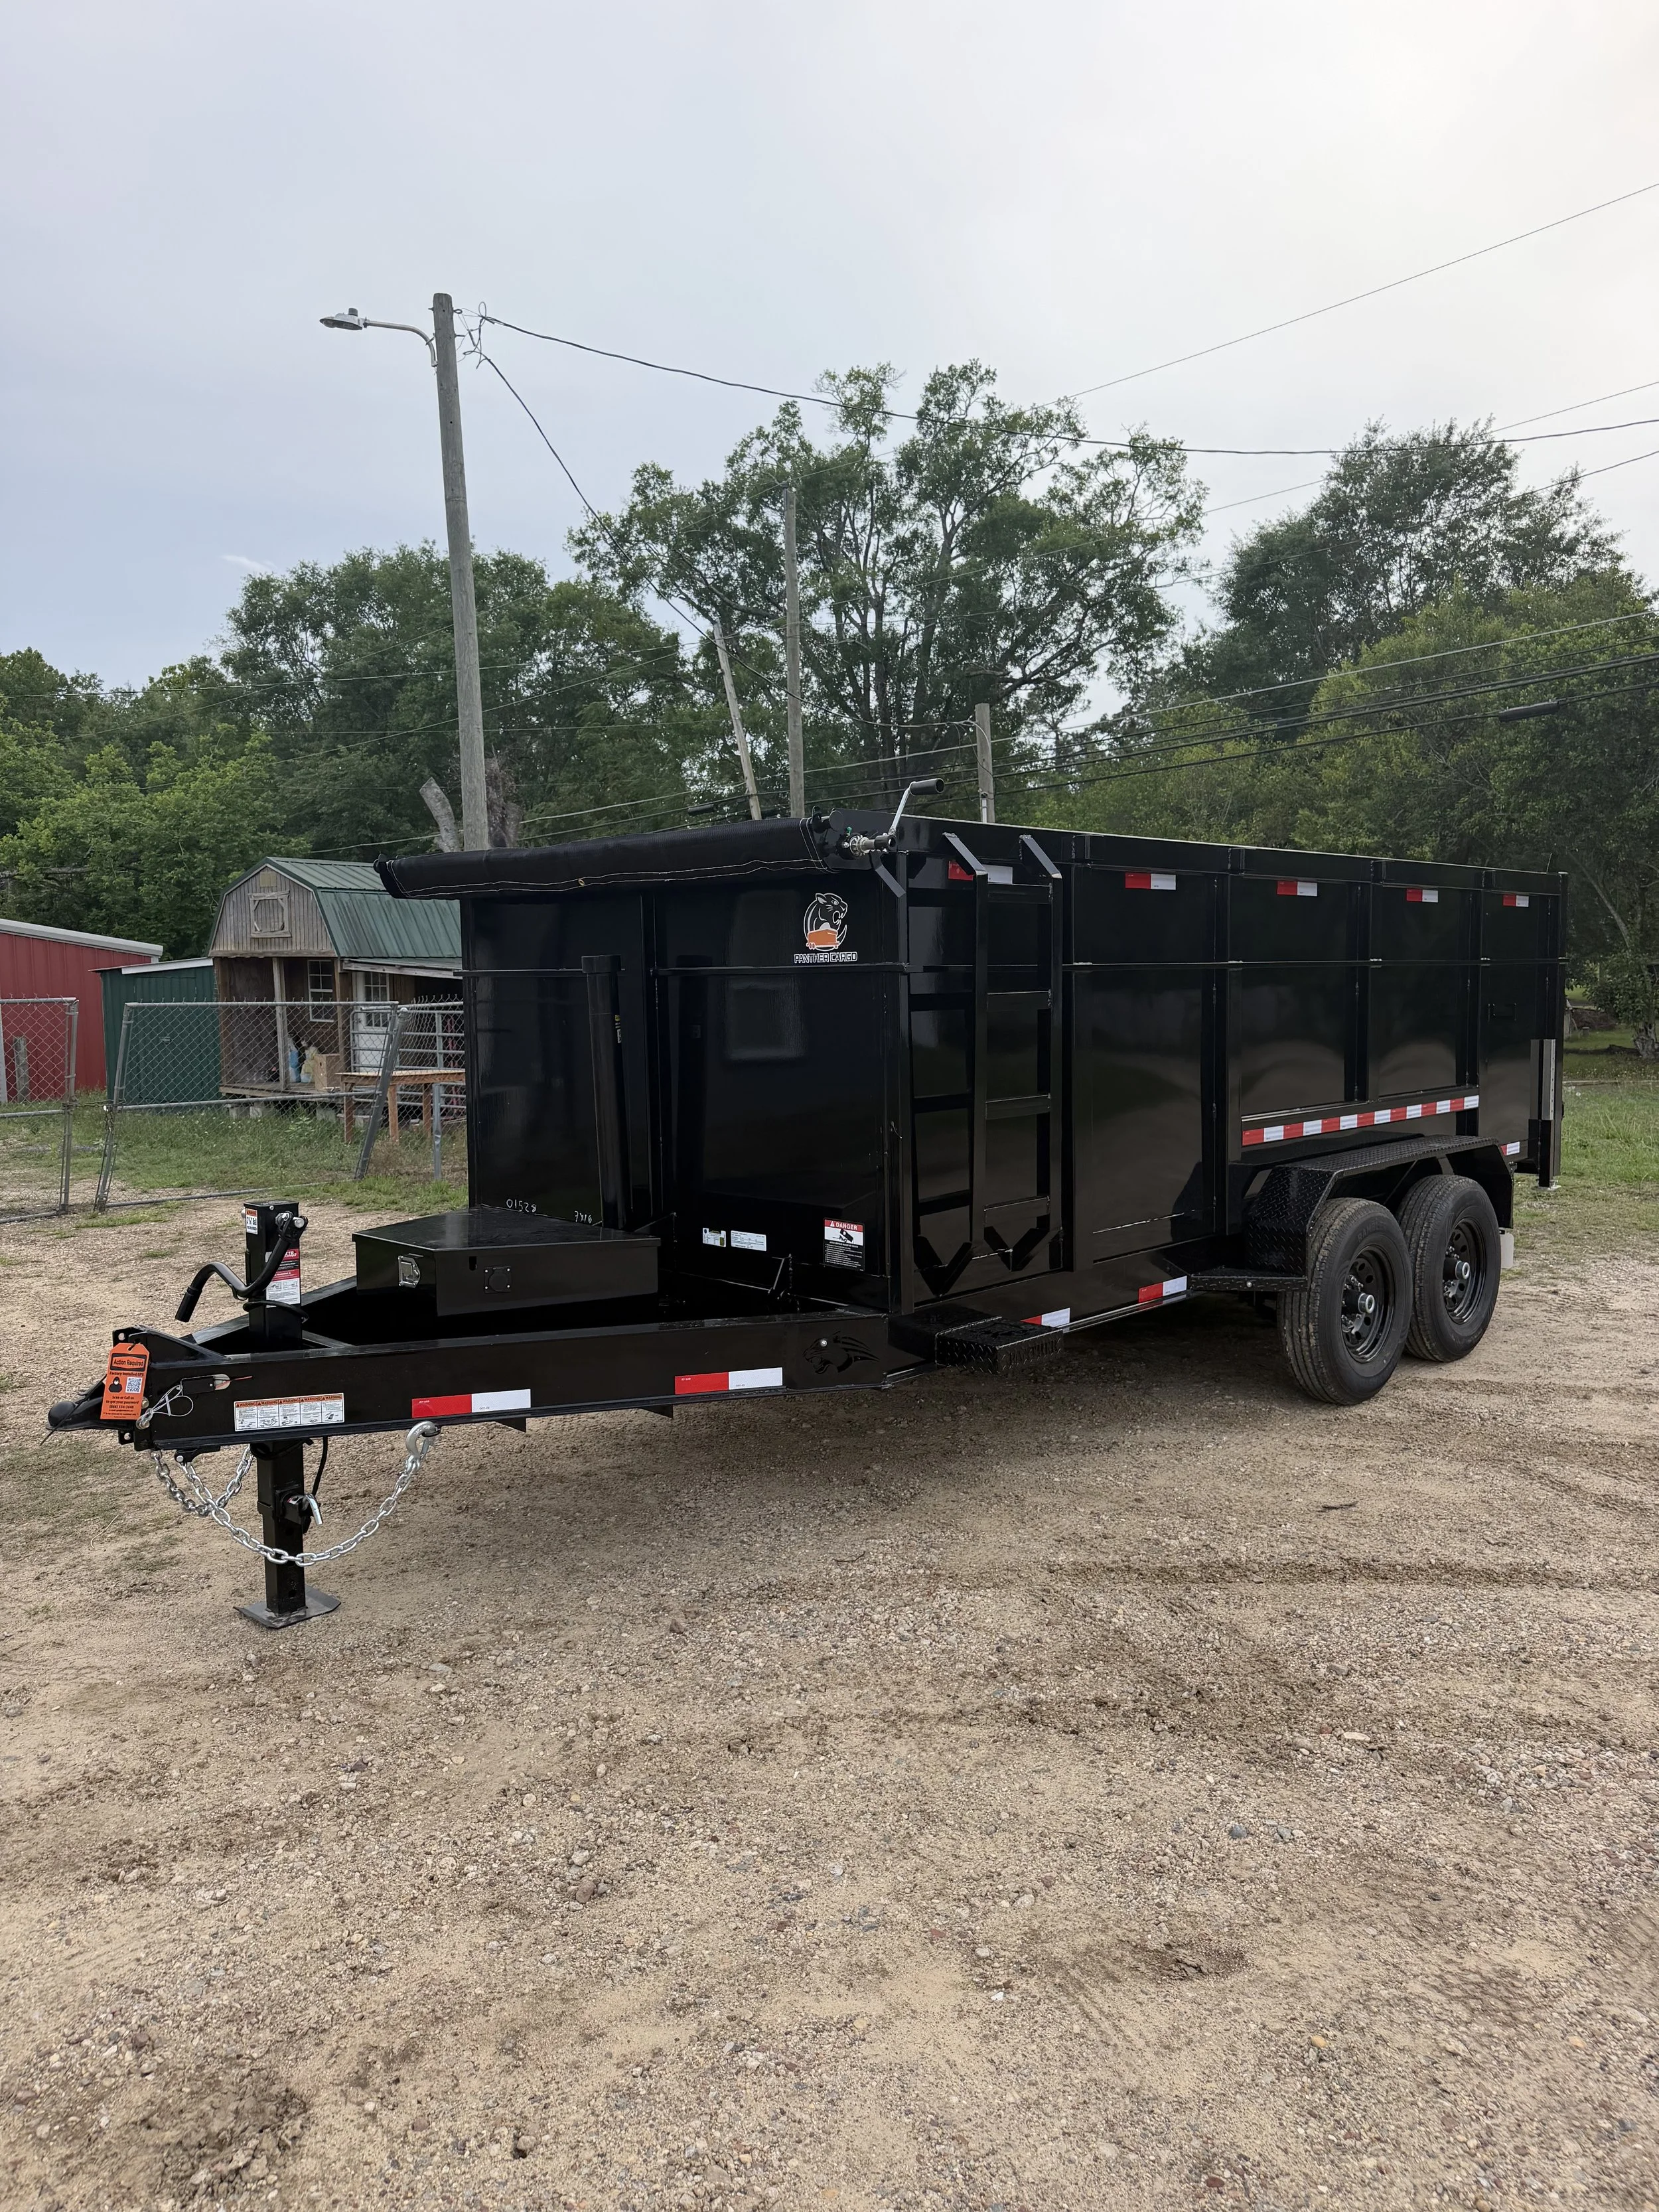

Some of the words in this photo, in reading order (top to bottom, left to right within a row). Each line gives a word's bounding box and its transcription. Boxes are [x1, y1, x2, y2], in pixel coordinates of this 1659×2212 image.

[794, 953, 830, 964] PANTHER
[830, 951, 858, 962] CARGO
[506, 1199, 537, 1213] 01528
